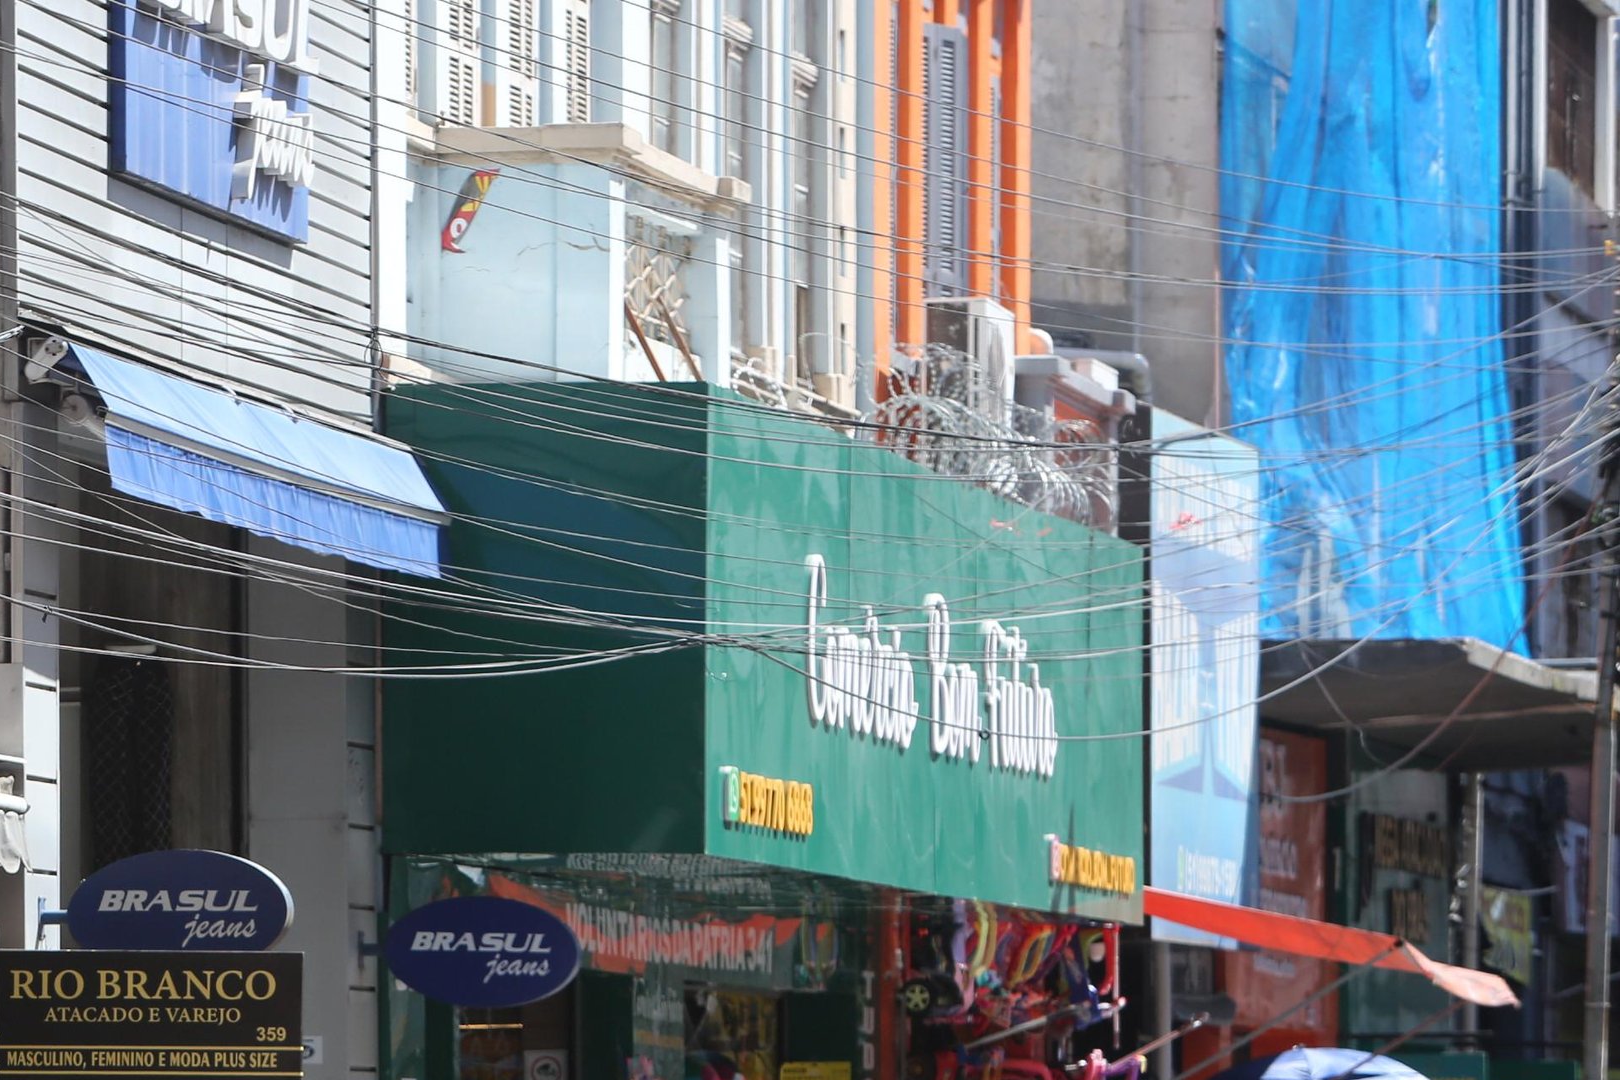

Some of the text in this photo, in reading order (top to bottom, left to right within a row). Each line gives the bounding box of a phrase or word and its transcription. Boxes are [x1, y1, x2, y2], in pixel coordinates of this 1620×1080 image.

[97, 889, 259, 912] BRASUL
[181, 913, 257, 948] jeans
[410, 931, 552, 953] BRASUL
[746, 926, 773, 974] 341
[483, 953, 551, 984] jeans
[9, 969, 277, 1000] RIO BRANCO
[44, 1006, 242, 1026] ATACADO E VAREJO
[256, 1026, 287, 1042] 359
[6, 1051, 278, 1070] MASCULINO, FEMININO E MODA PLUS SIZE
